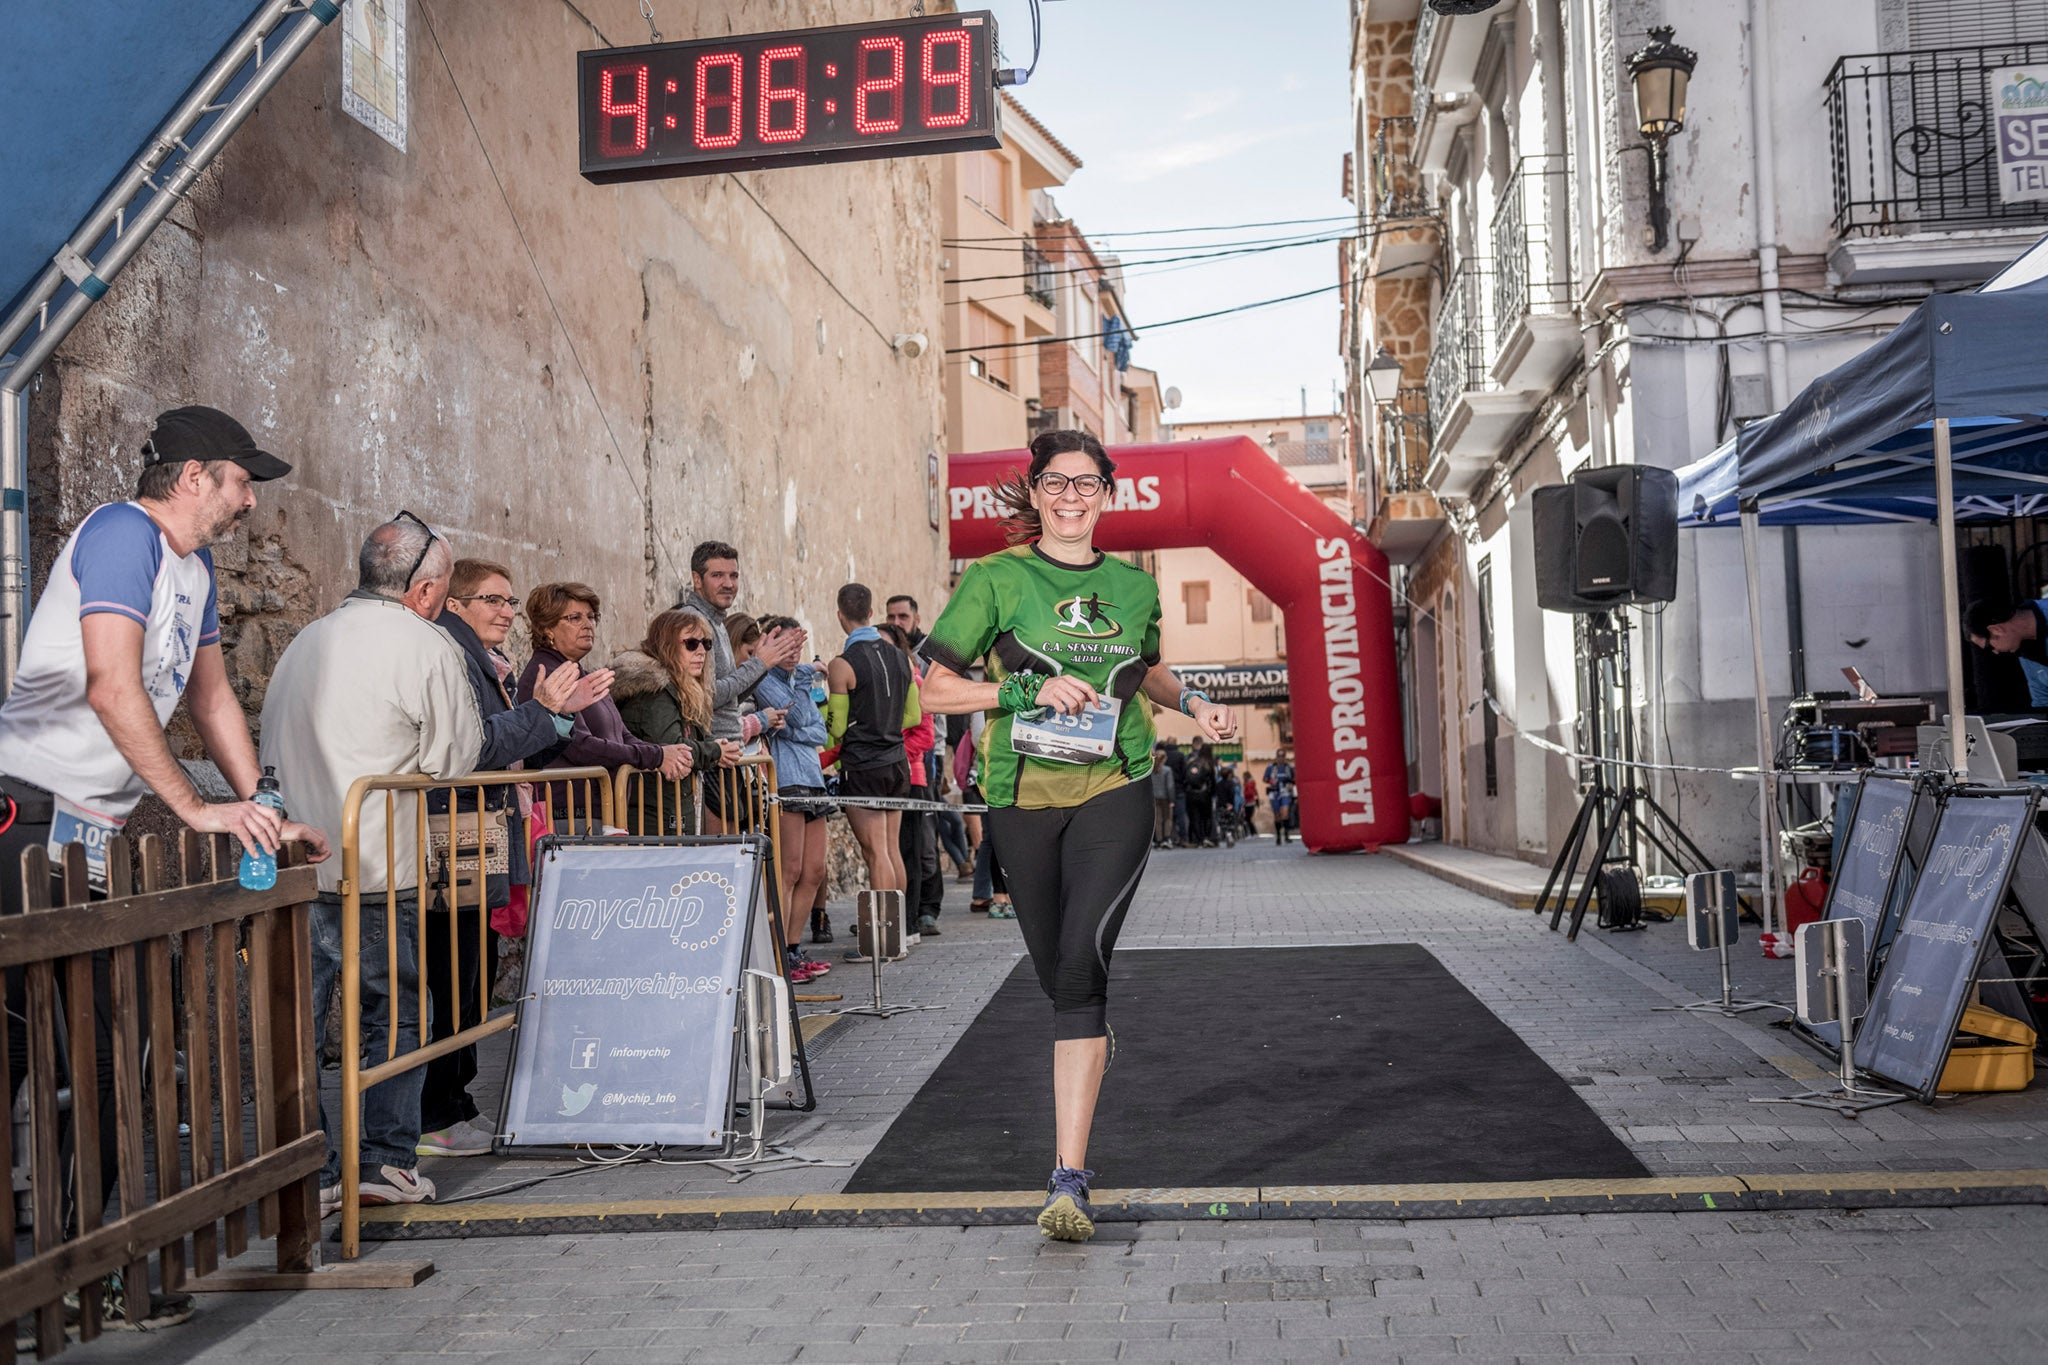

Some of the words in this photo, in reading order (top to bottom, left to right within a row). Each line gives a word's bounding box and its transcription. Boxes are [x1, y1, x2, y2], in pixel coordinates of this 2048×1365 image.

[602, 31, 971, 150] 4:06:29
[1042, 642, 1063, 652] C.A.
[1067, 642, 1101, 652] SENSE
[1103, 644, 1136, 656] LIMITS
[1316, 537, 1368, 752] PROVINCIAS
[1335, 756, 1375, 826] LAS
[554, 885, 704, 940] mychip
[544, 972, 722, 1000] www.mychip.es
[609, 1046, 671, 1060] /infomychip
[602, 1092, 677, 1106] @Mychip_Info
